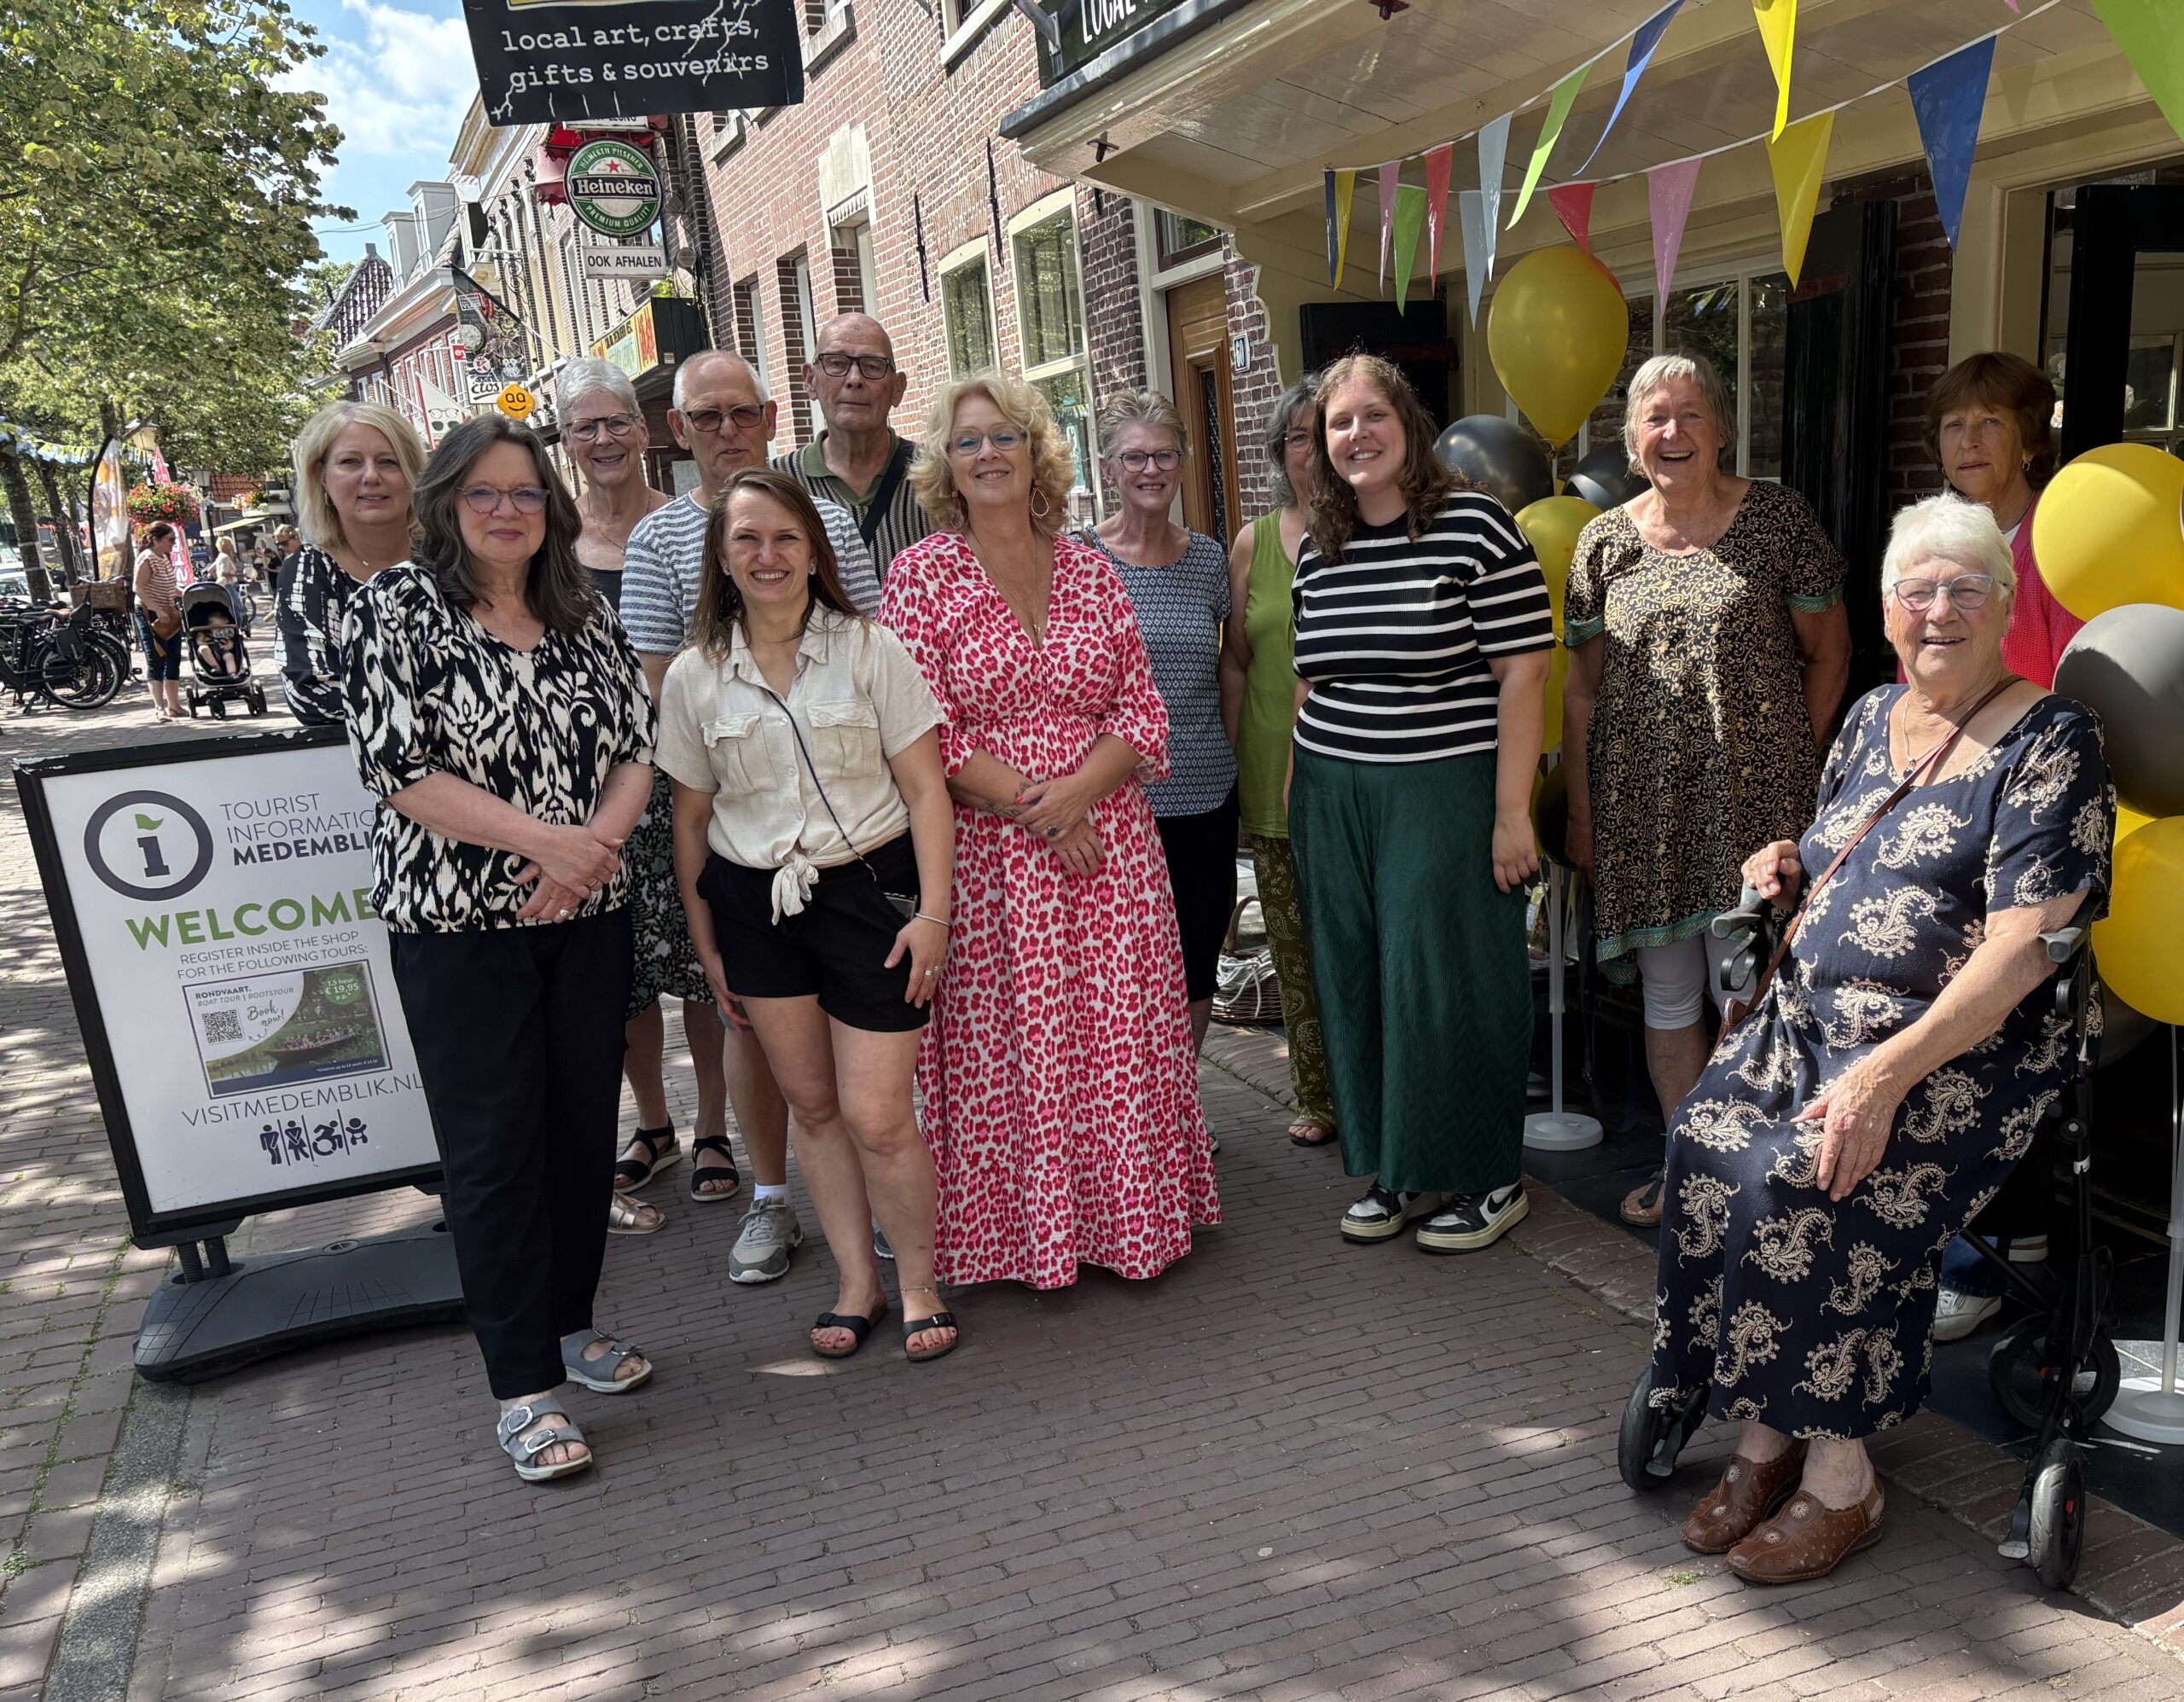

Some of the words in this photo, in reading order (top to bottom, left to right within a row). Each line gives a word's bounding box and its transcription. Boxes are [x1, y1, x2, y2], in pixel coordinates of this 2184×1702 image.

[501, 26, 587, 51] local
[593, 22, 650, 47] art,
[654, 16, 759, 41] crafts,
[1080, 0, 1137, 44] LOC
[509, 62, 594, 93] gifts
[602, 63, 617, 81] &
[624, 54, 770, 80] souvenirs
[579, 148, 611, 170] HEINEKEN
[612, 147, 644, 170] PILSENER
[577, 179, 654, 195] Heineken
[585, 206, 621, 228] PREMIUM
[624, 206, 651, 227] QUALITY
[587, 255, 611, 267] OOK
[615, 255, 662, 268] AFHALEN
[219, 793, 320, 821] TOURIST
[226, 809, 375, 844] INFORMATIO
[233, 831, 372, 866] MEDEMBLI
[125, 886, 380, 951] WELCOME
[177, 966, 206, 979] FOR
[208, 961, 235, 975] THE
[238, 951, 319, 973] FOLLOWING
[319, 944, 369, 959] TOURS:
[180, 945, 244, 964] REGISTER
[247, 940, 291, 956] INSIDE
[293, 936, 318, 949] THE
[321, 931, 359, 945] SHOP
[195, 985, 252, 1000] RONDVAART.
[197, 997, 217, 1007] BOAT
[218, 995, 241, 1003] TOUR
[248, 987, 294, 1000] BOOTSTOUR
[334, 983, 359, 994] 19,95
[247, 1000, 279, 1021] Book
[261, 1008, 285, 1028] now!
[181, 1072, 424, 1127] VISITMEDEMBLIK.NL
